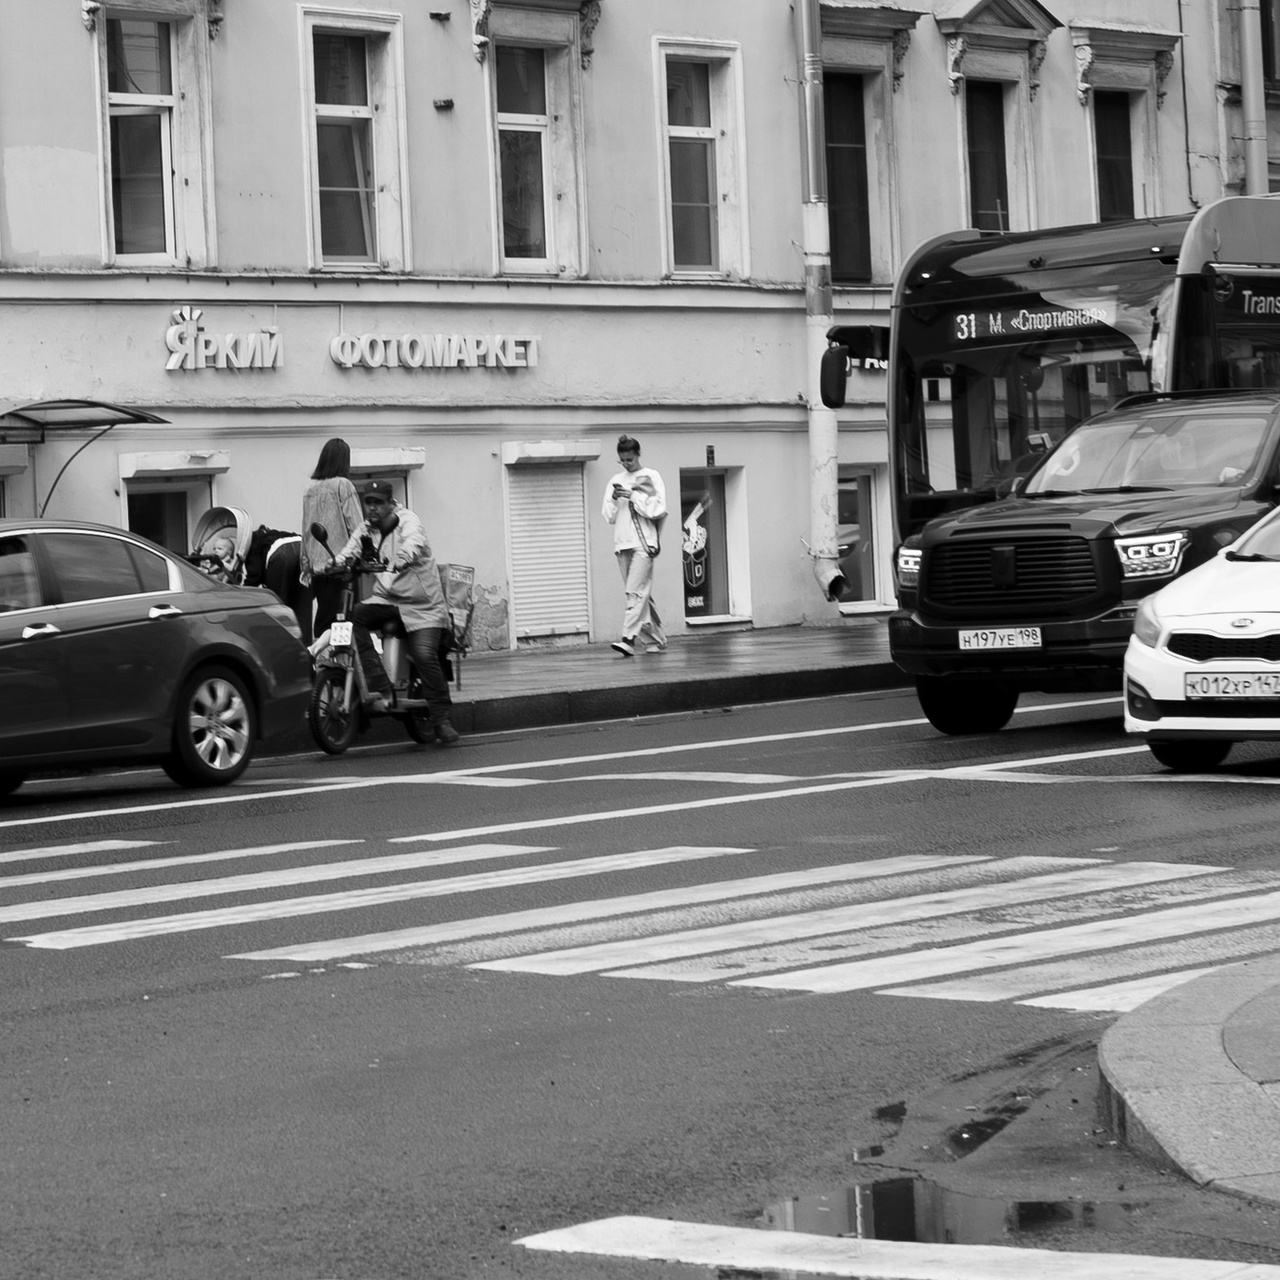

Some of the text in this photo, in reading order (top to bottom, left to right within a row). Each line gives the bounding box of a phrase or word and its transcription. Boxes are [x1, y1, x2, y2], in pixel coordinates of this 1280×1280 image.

[956, 313, 977, 340] 31
[1010, 308, 1108, 331] «Спортивная»
[329, 332, 542, 369] ФОТОМАРКЕТ
